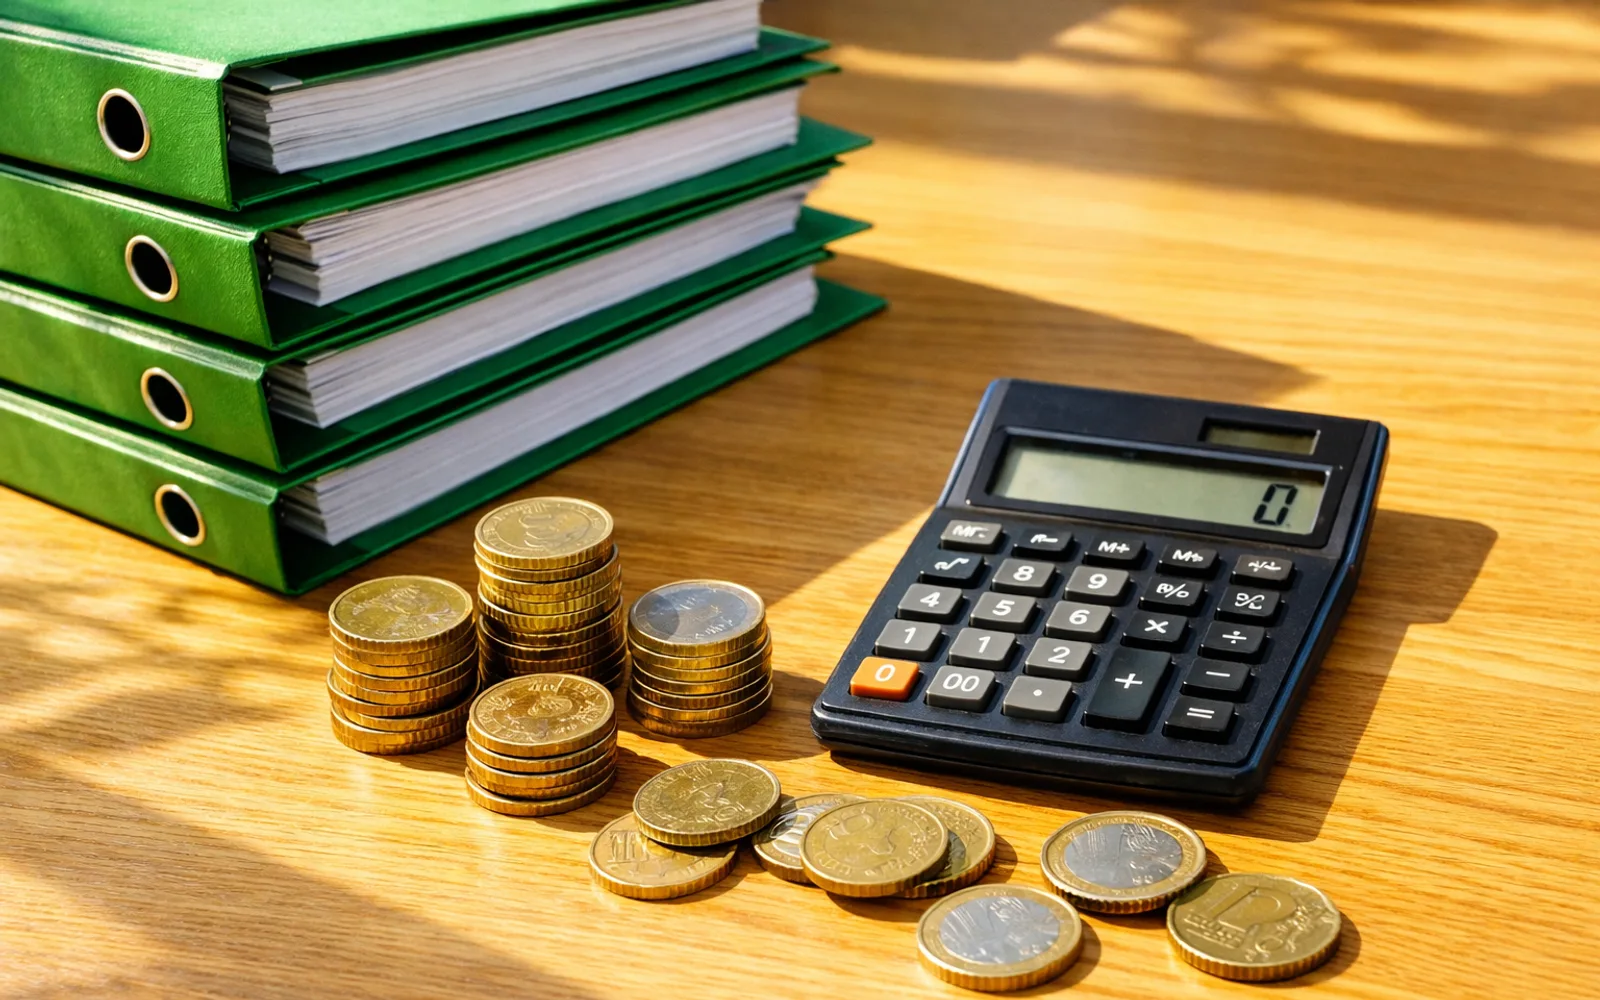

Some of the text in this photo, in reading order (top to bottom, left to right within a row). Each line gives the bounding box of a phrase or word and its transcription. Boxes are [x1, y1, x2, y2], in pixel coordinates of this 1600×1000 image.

[1253, 483, 1298, 525] 0
[1098, 541, 1130, 554] M+
[1013, 565, 1035, 582] 8
[1087, 573, 1108, 589] 9
[919, 591, 941, 608] 4
[992, 599, 1015, 616] 5
[1069, 609, 1091, 625] 6
[904, 627, 917, 644] 1
[978, 635, 991, 653] 1
[1047, 646, 1071, 664] 2
[874, 663, 896, 682] 0
[942, 673, 980, 692] 00
